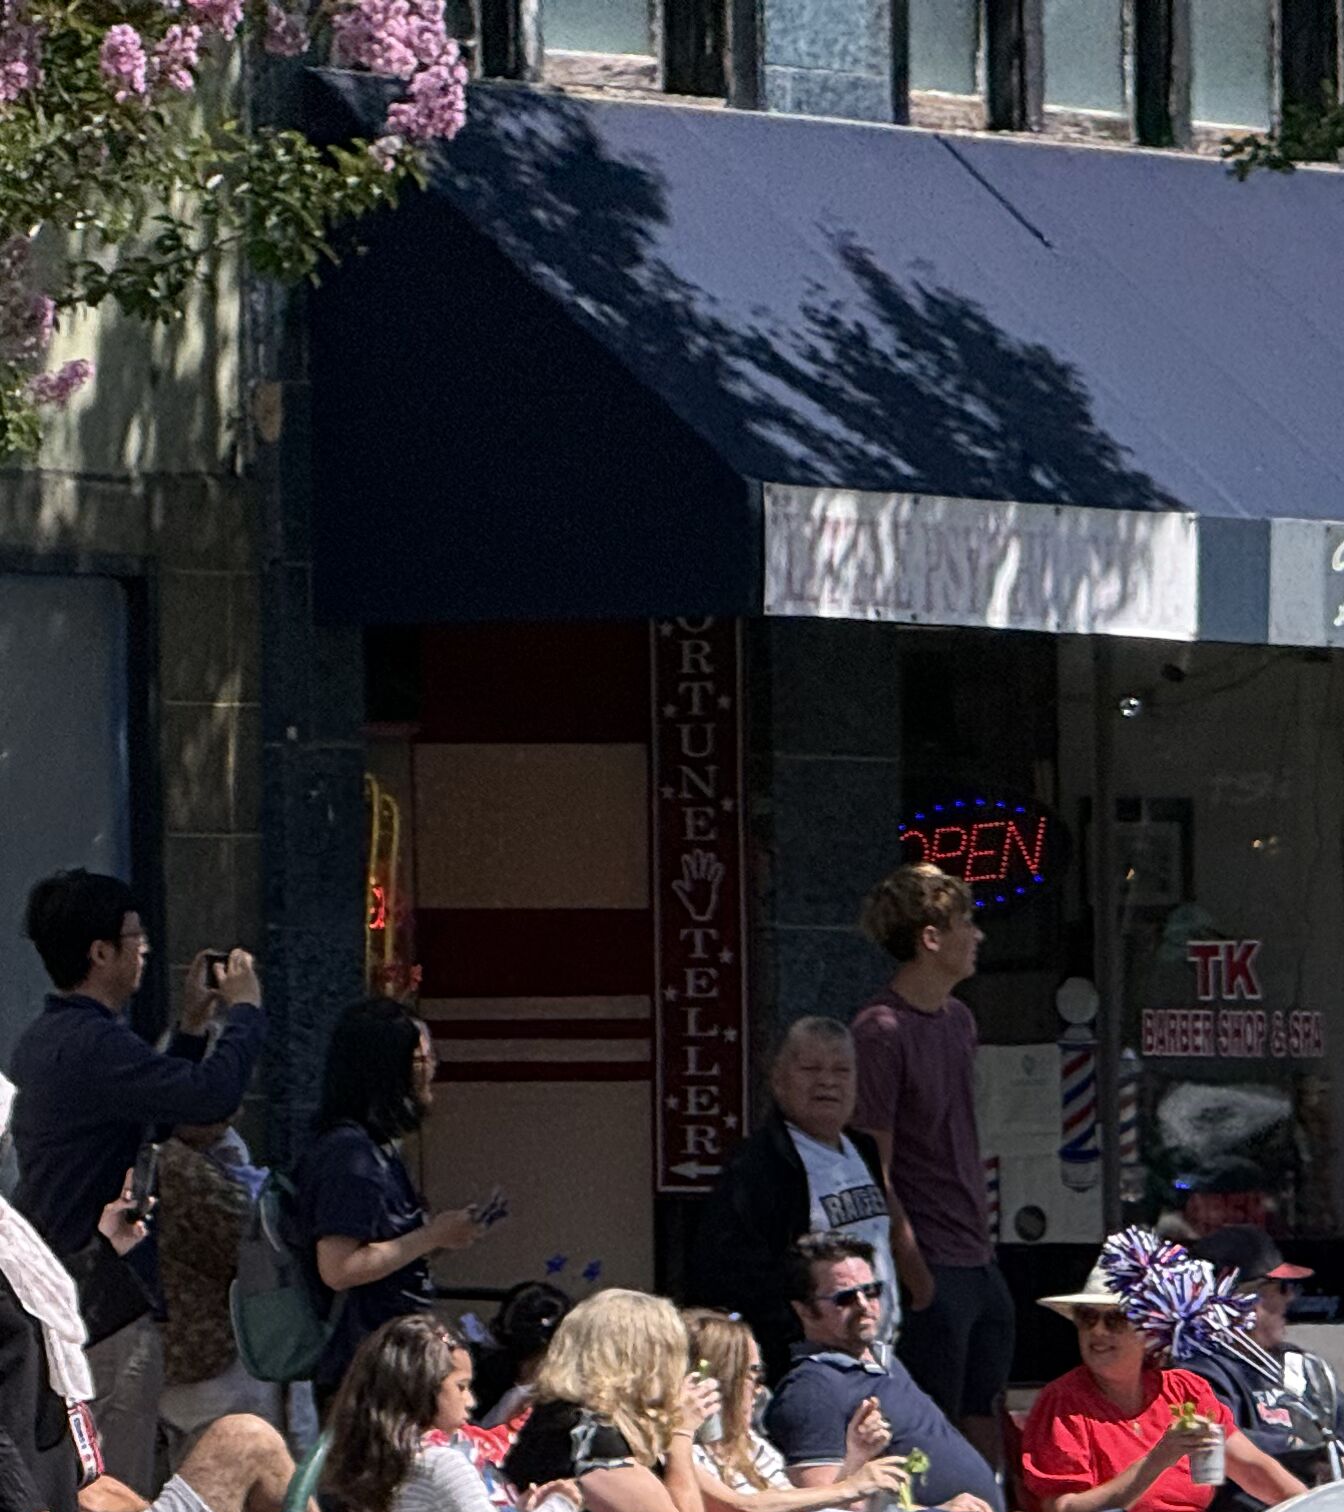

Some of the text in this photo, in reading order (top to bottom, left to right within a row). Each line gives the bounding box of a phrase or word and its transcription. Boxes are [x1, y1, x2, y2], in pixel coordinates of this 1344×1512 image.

[674, 617, 723, 1157] RTUNE TELLER
[1186, 939, 1263, 1001] TK
[1141, 1008, 1215, 1057] BARBER
[1217, 1008, 1265, 1058] SHOP
[1288, 1010, 1325, 1059] SPA
